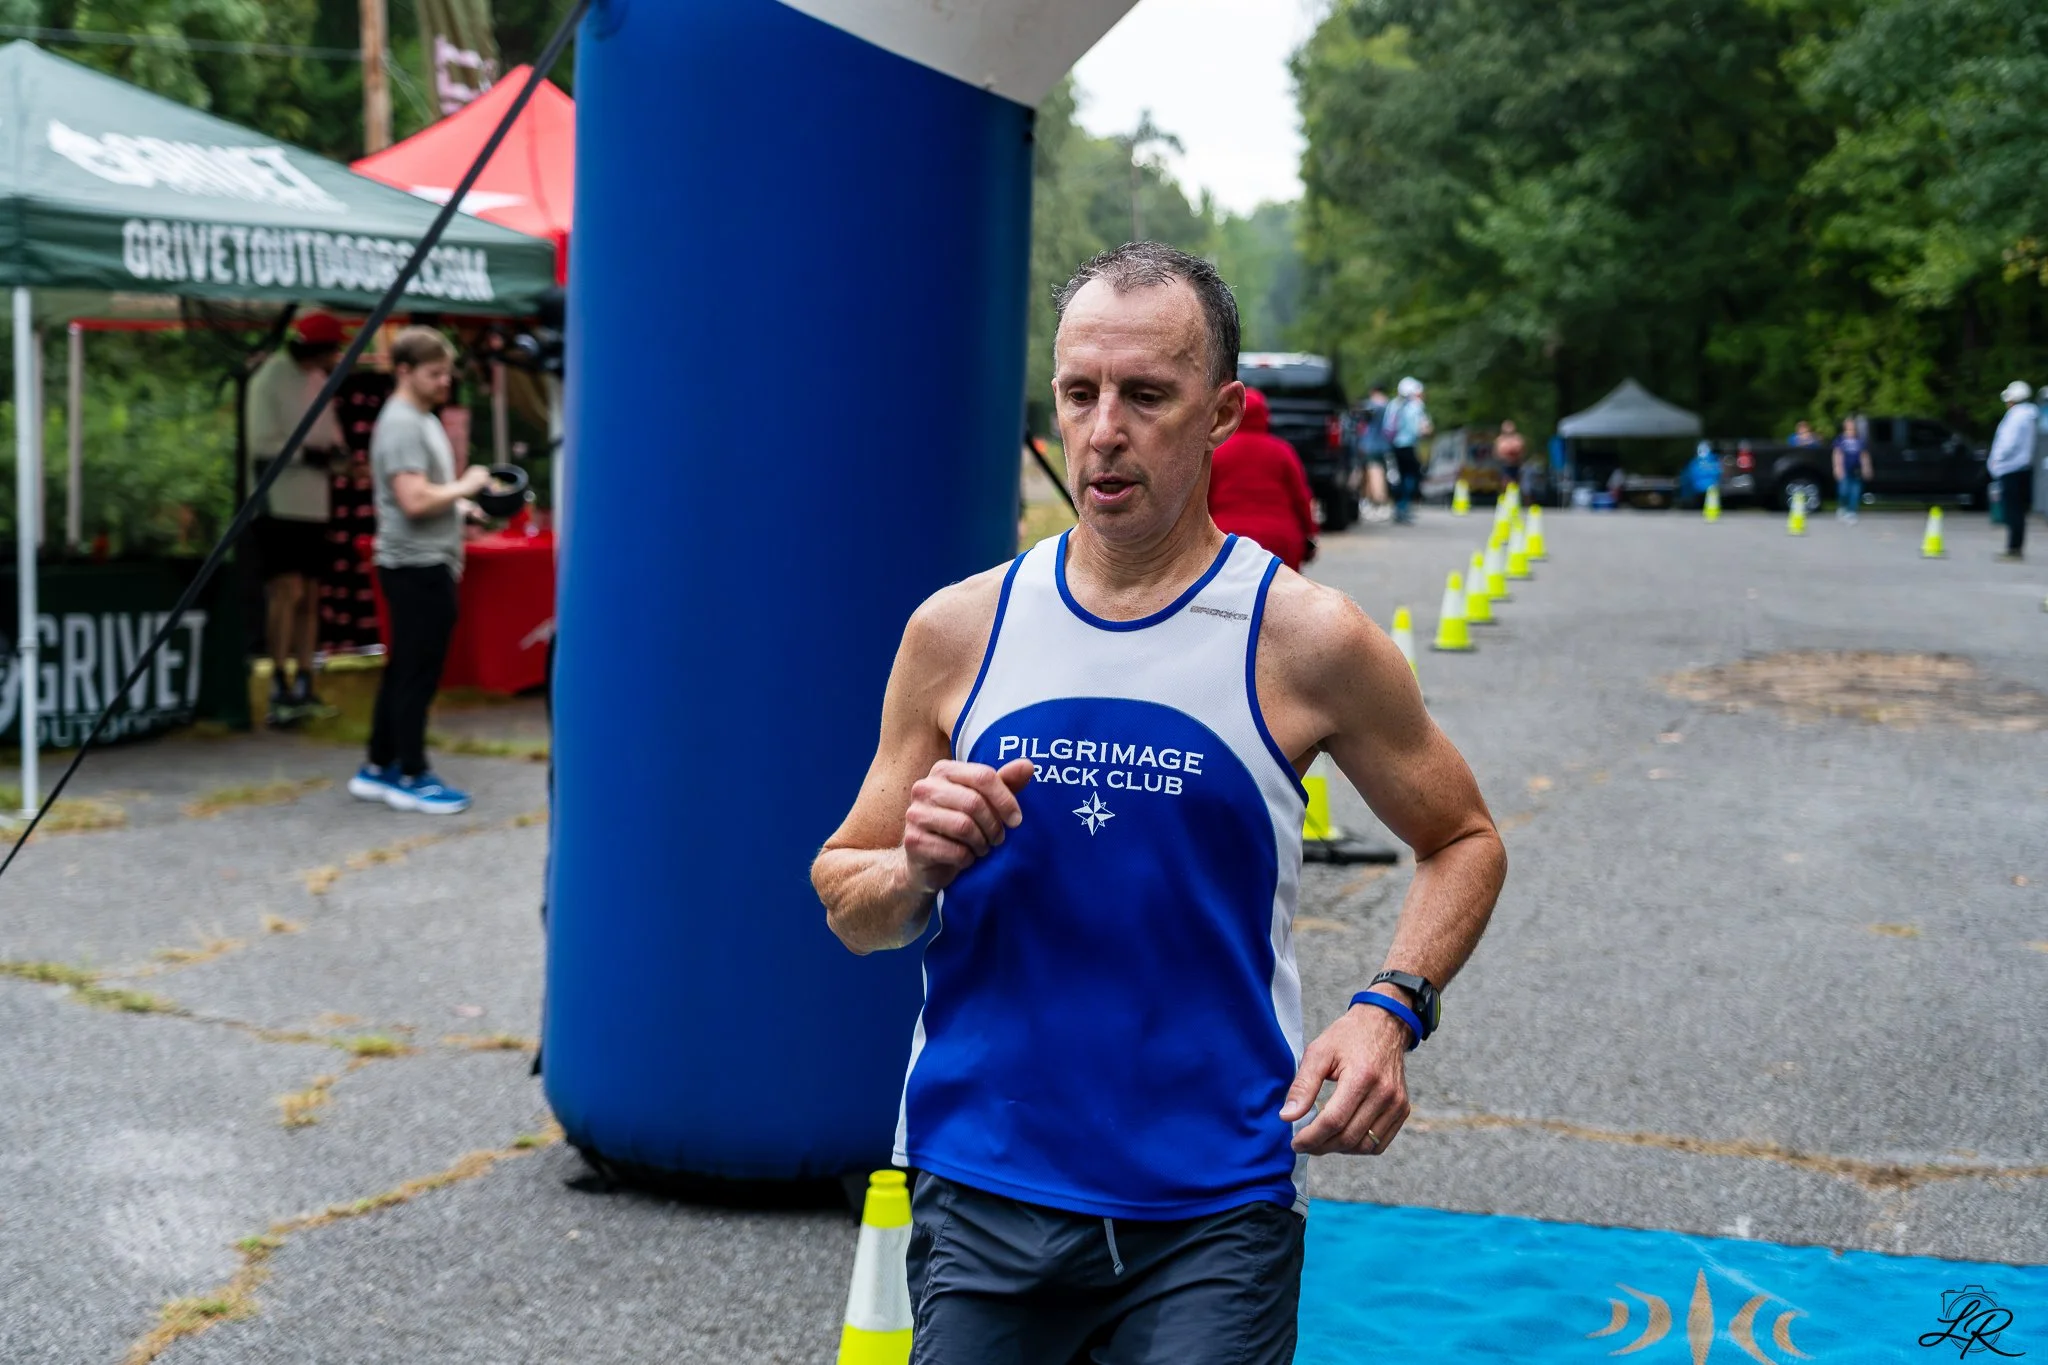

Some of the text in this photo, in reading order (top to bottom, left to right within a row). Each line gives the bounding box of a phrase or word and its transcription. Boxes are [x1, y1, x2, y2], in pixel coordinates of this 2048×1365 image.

[36, 609, 208, 716] GRIVET
[998, 735, 1204, 775] PILGRIMAGE
[1029, 764, 1184, 795] RACK CLUB
